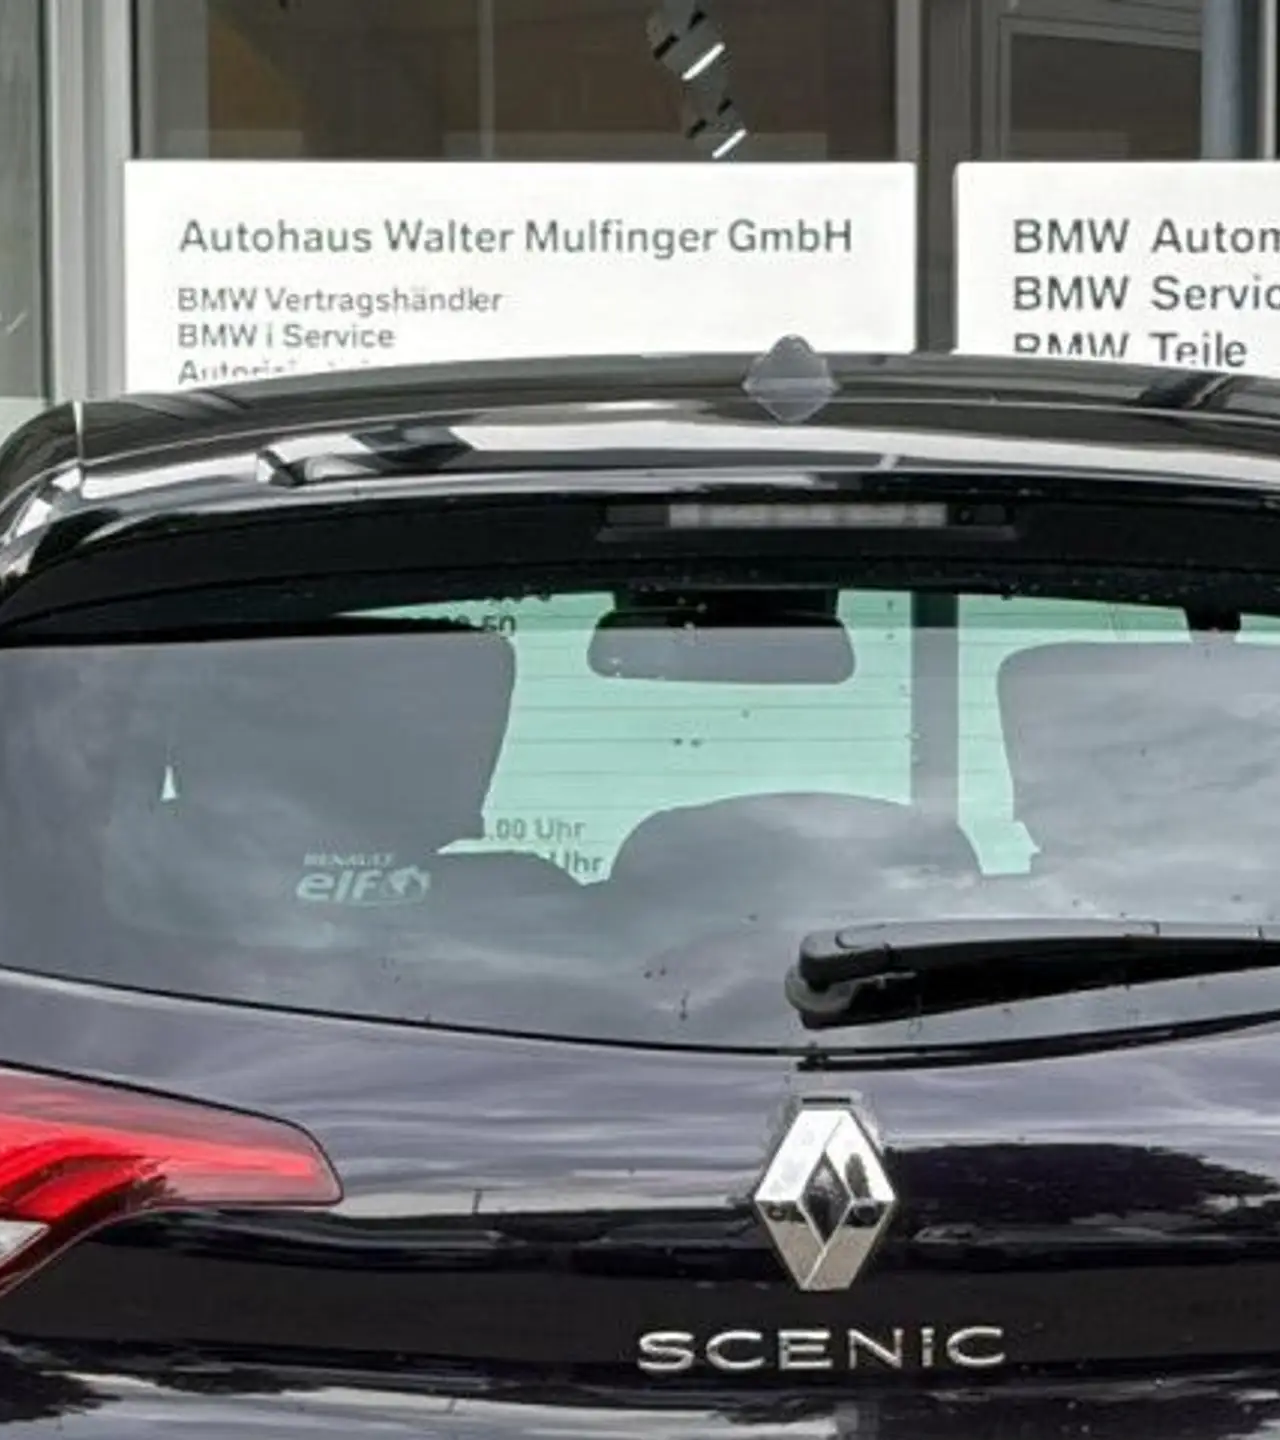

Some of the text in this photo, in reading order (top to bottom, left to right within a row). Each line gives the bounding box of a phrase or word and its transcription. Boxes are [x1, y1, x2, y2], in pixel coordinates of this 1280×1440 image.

[179, 218, 852, 260] Autohaus Walter Mulfinger GmbH
[1013, 218, 1130, 254] BMW
[177, 286, 504, 319] BMW Vertragshändler
[1013, 275, 1130, 311] BMW
[177, 323, 258, 349] BMW
[282, 323, 396, 349] Service
[1149, 331, 1248, 366] Teile
[534, 816, 587, 843] Uhr
[638, 1326, 1005, 1371] SCENIC
